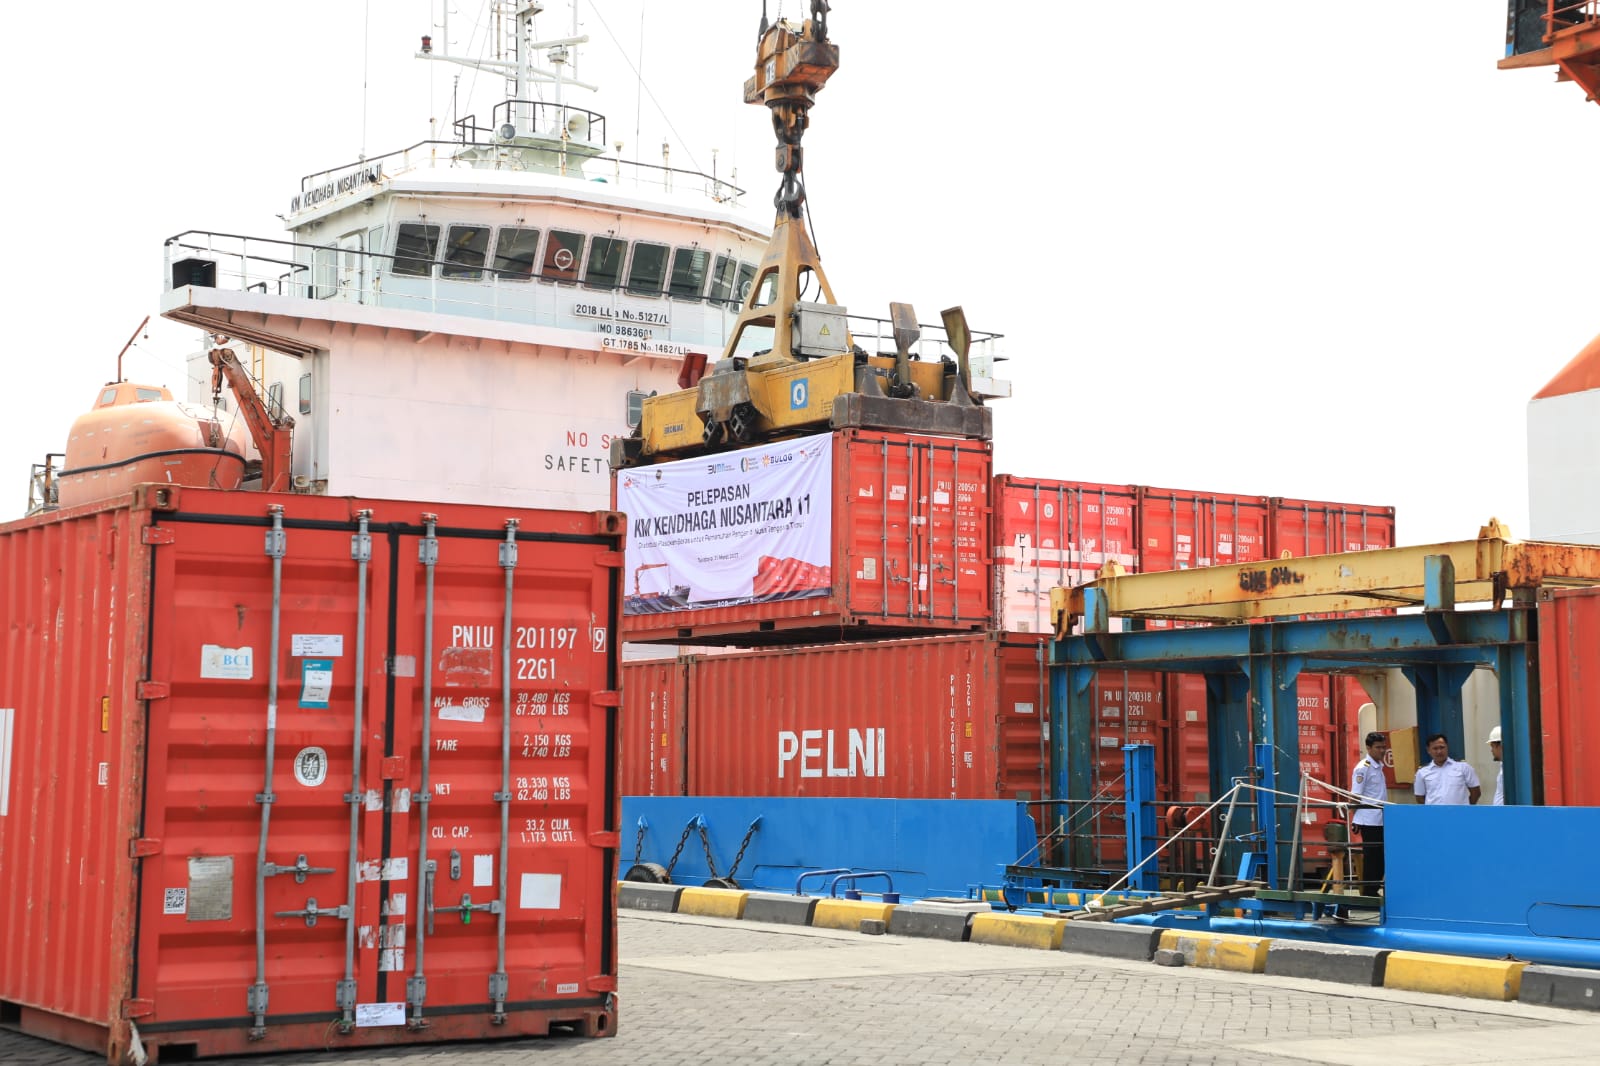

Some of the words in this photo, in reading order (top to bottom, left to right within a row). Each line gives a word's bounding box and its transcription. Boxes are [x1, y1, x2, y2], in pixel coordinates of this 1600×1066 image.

[291, 194, 301, 214] KM
[303, 183, 335, 209] KENDHAGA
[575, 303, 597, 316] 2018
[597, 322, 612, 335] IMO
[603, 337, 639, 351] GT.1785
[566, 431, 588, 448] NO
[770, 453, 793, 464] BULOG
[687, 483, 751, 508] PELEPASAN
[633, 517, 652, 539] KM
[653, 507, 718, 537] KENDHAGA
[719, 496, 794, 528] NUSANTARA
[452, 625, 494, 648] PNIU
[516, 627, 577, 649] 201197
[594, 629, 605, 650] 9
[223, 655, 249, 666] BCI
[517, 658, 556, 680] 22G1
[434, 697, 453, 708] MAX
[462, 697, 490, 708] GROSS
[517, 693, 548, 703] 30.480
[553, 693, 570, 703] KGS
[1128, 692, 1152, 702] 200318
[1297, 697, 1319, 707] 201322
[516, 704, 547, 716] 67.200
[552, 704, 569, 715] LBS
[1128, 705, 1144, 716] 22G1
[1298, 710, 1312, 721] 22G1
[436, 739, 459, 751] TARE
[523, 734, 549, 746] 2.150
[555, 734, 572, 746] KGS
[522, 747, 548, 758] 4.740
[553, 746, 570, 757] LBS
[778, 727, 885, 779] PELNI
[516, 777, 548, 788] 28.330
[552, 777, 570, 788] KGS
[435, 783, 451, 795] NET
[517, 789, 548, 801] 62.460
[554, 789, 571, 800] LBS
[526, 819, 545, 831] 33.2
[432, 826, 447, 838] CU.
[451, 826, 472, 838] CAP.
[521, 831, 546, 843] 1.173
